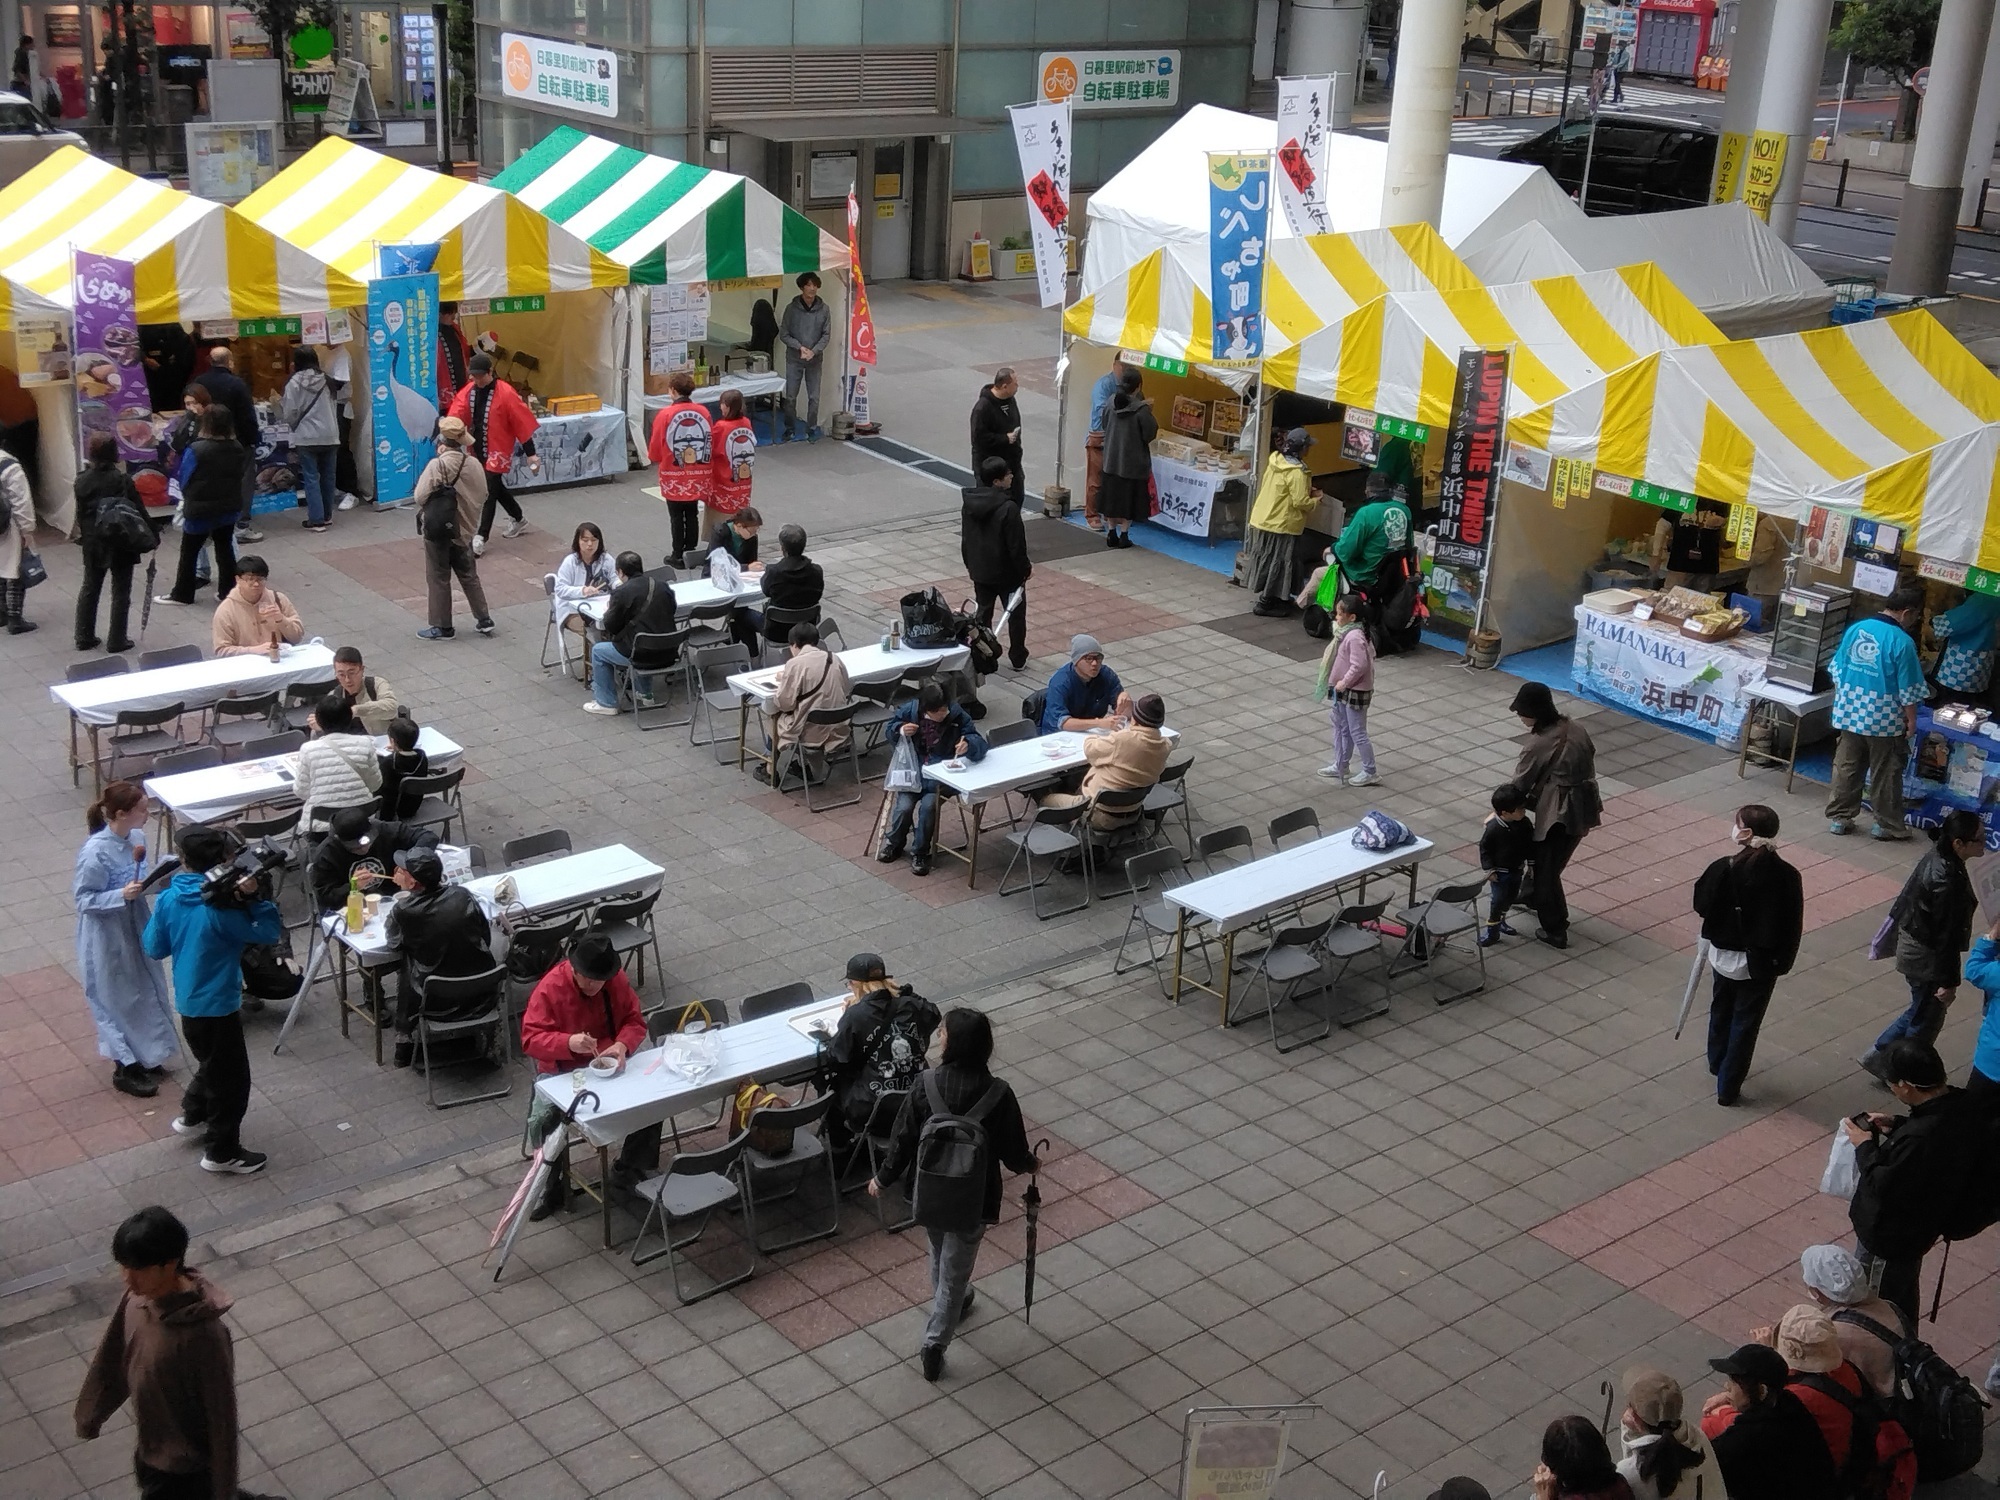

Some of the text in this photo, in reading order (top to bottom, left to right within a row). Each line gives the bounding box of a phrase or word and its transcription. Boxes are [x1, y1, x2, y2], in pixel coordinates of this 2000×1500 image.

[537, 50, 595, 74] 日暮里駅前地下
[1084, 60, 1156, 75] 日暮里駅前地下
[538, 73, 610, 108] 自転車駐車場
[1083, 80, 1170, 102] 自転車駐車場
[1754, 138, 1779, 159] NO!!
[76, 274, 132, 304] しらぬか
[1150, 356, 1185, 374] 釧路市
[1450, 358, 1477, 474] モンキー・パンチの故郷
[1460, 354, 1505, 544] LUPIN THE THIRD
[1438, 475, 1465, 540] 浜中町
[1637, 485, 1692, 510] 浜中町
[1435, 544, 1477, 561] ルパン三世
[1586, 613, 1687, 669] HAMANAKA
[1640, 677, 1725, 728] 浜中町
